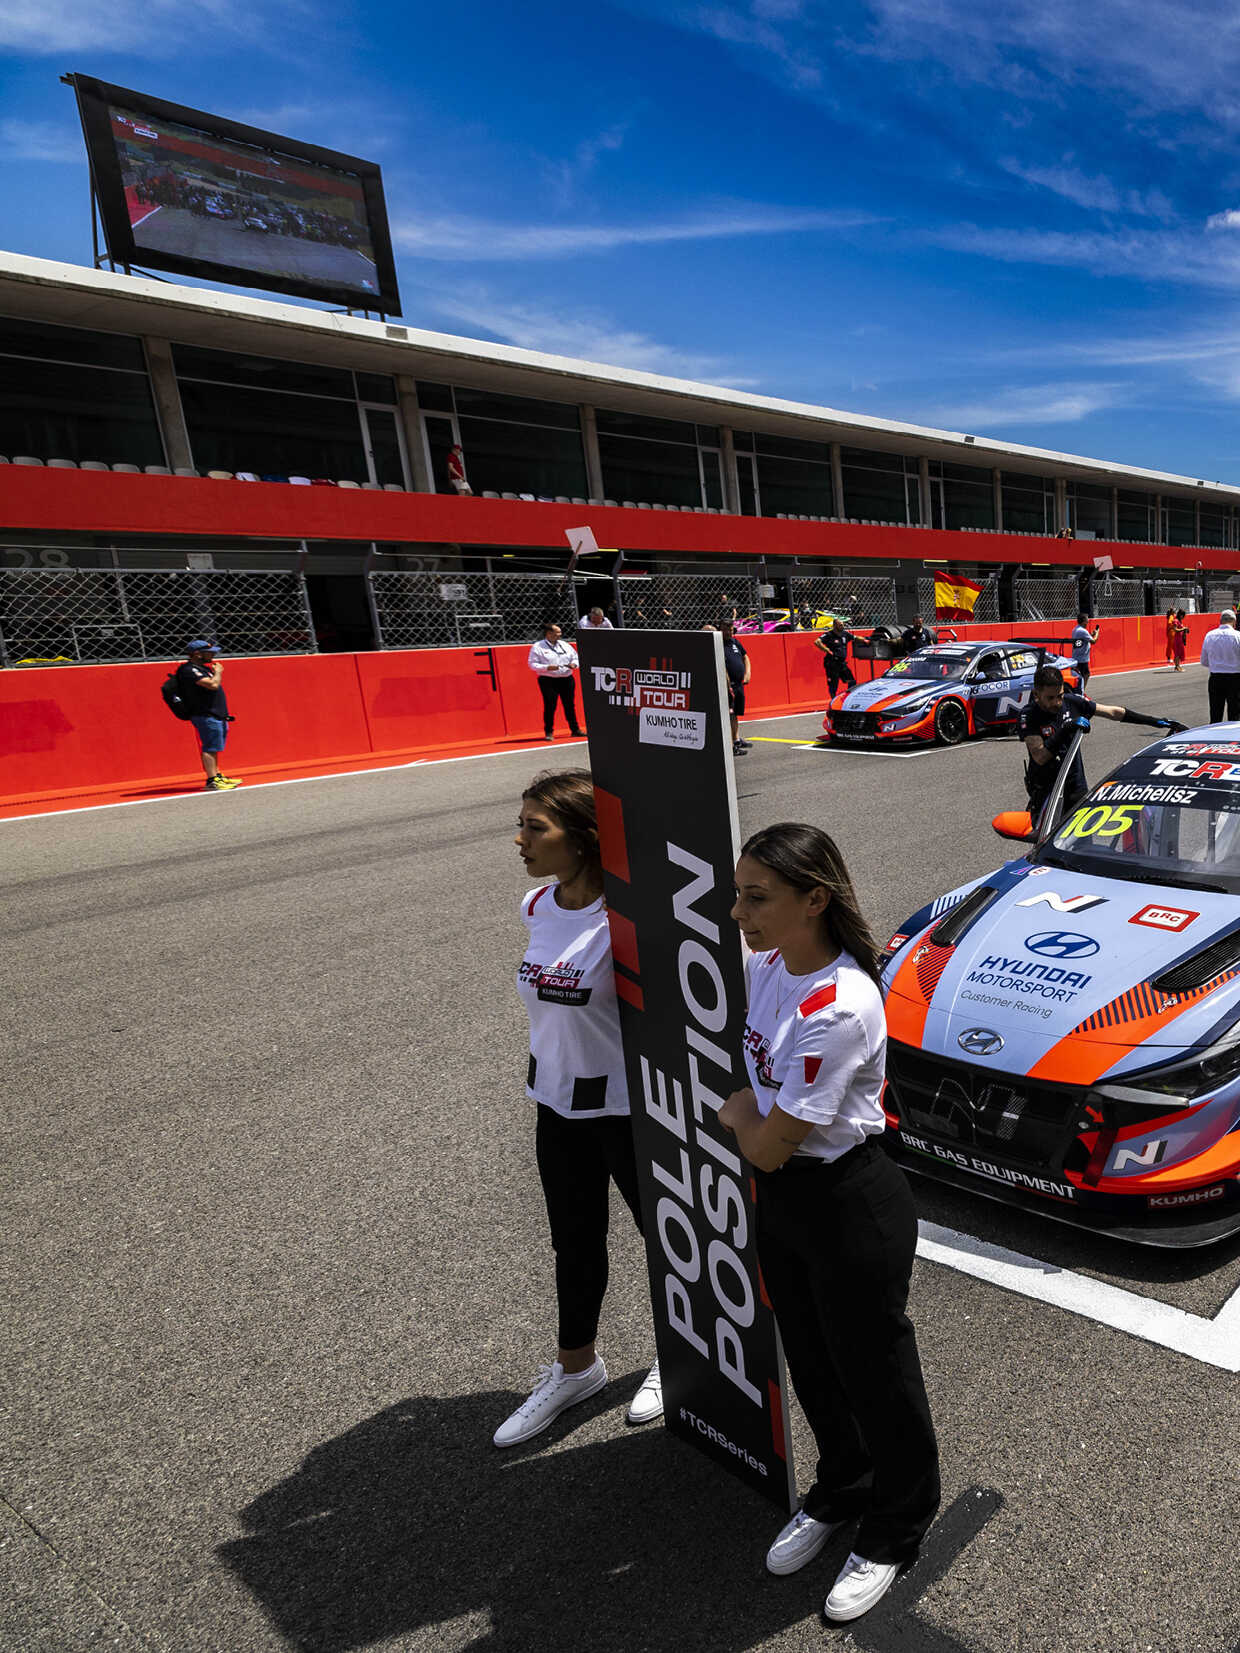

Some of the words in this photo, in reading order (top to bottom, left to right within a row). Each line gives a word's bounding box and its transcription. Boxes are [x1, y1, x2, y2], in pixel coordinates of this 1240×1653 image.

[591, 666, 632, 693] TCR
[636, 672, 675, 687] WORLD
[643, 690, 686, 708] TOUR
[646, 714, 677, 728] KUMHO
[678, 717, 698, 730] TIRE
[1150, 759, 1232, 779] TCR
[1090, 784, 1200, 804] N.Michelisz
[1060, 804, 1145, 839] 105
[1149, 911, 1181, 922] BRC
[519, 961, 543, 977] CR
[544, 976, 576, 987] TOUR
[979, 955, 1093, 990] HYUNDAI
[966, 971, 1078, 1003] MOTORSPORT
[960, 989, 1013, 1008] Customer
[1013, 1000, 1053, 1019] Racing
[666, 840, 763, 1409] POSITION
[900, 1131, 932, 1153] BRC
[933, 1145, 969, 1166] GAS
[972, 1158, 1077, 1199] EQUIPMENT
[641, 1054, 710, 1360] POLE
[1150, 1187, 1224, 1206] KUMHO
[680, 1407, 768, 1476] #TCRSeries
